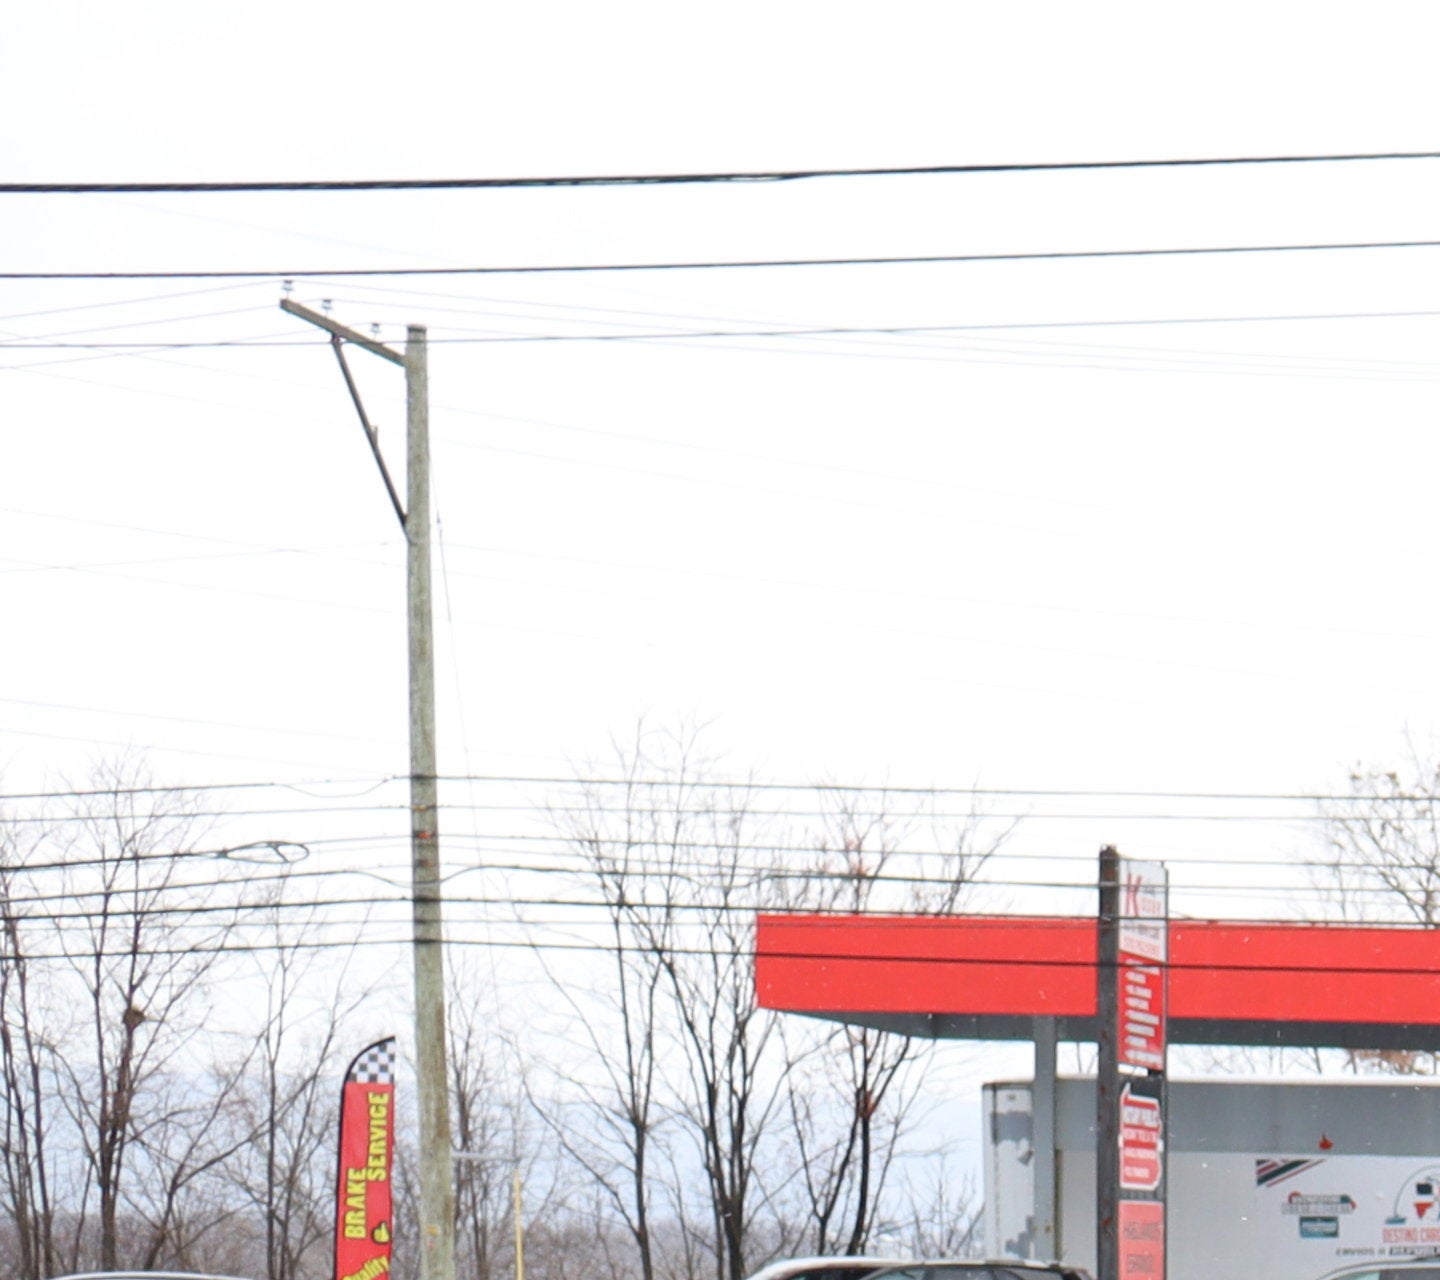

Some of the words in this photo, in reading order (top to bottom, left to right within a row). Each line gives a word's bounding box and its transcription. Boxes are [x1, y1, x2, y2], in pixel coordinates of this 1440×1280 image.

[367, 1091, 390, 1182] SERVICE
[344, 1167, 367, 1240] BRAKE
[1382, 1227, 1418, 1243] DESTINO
